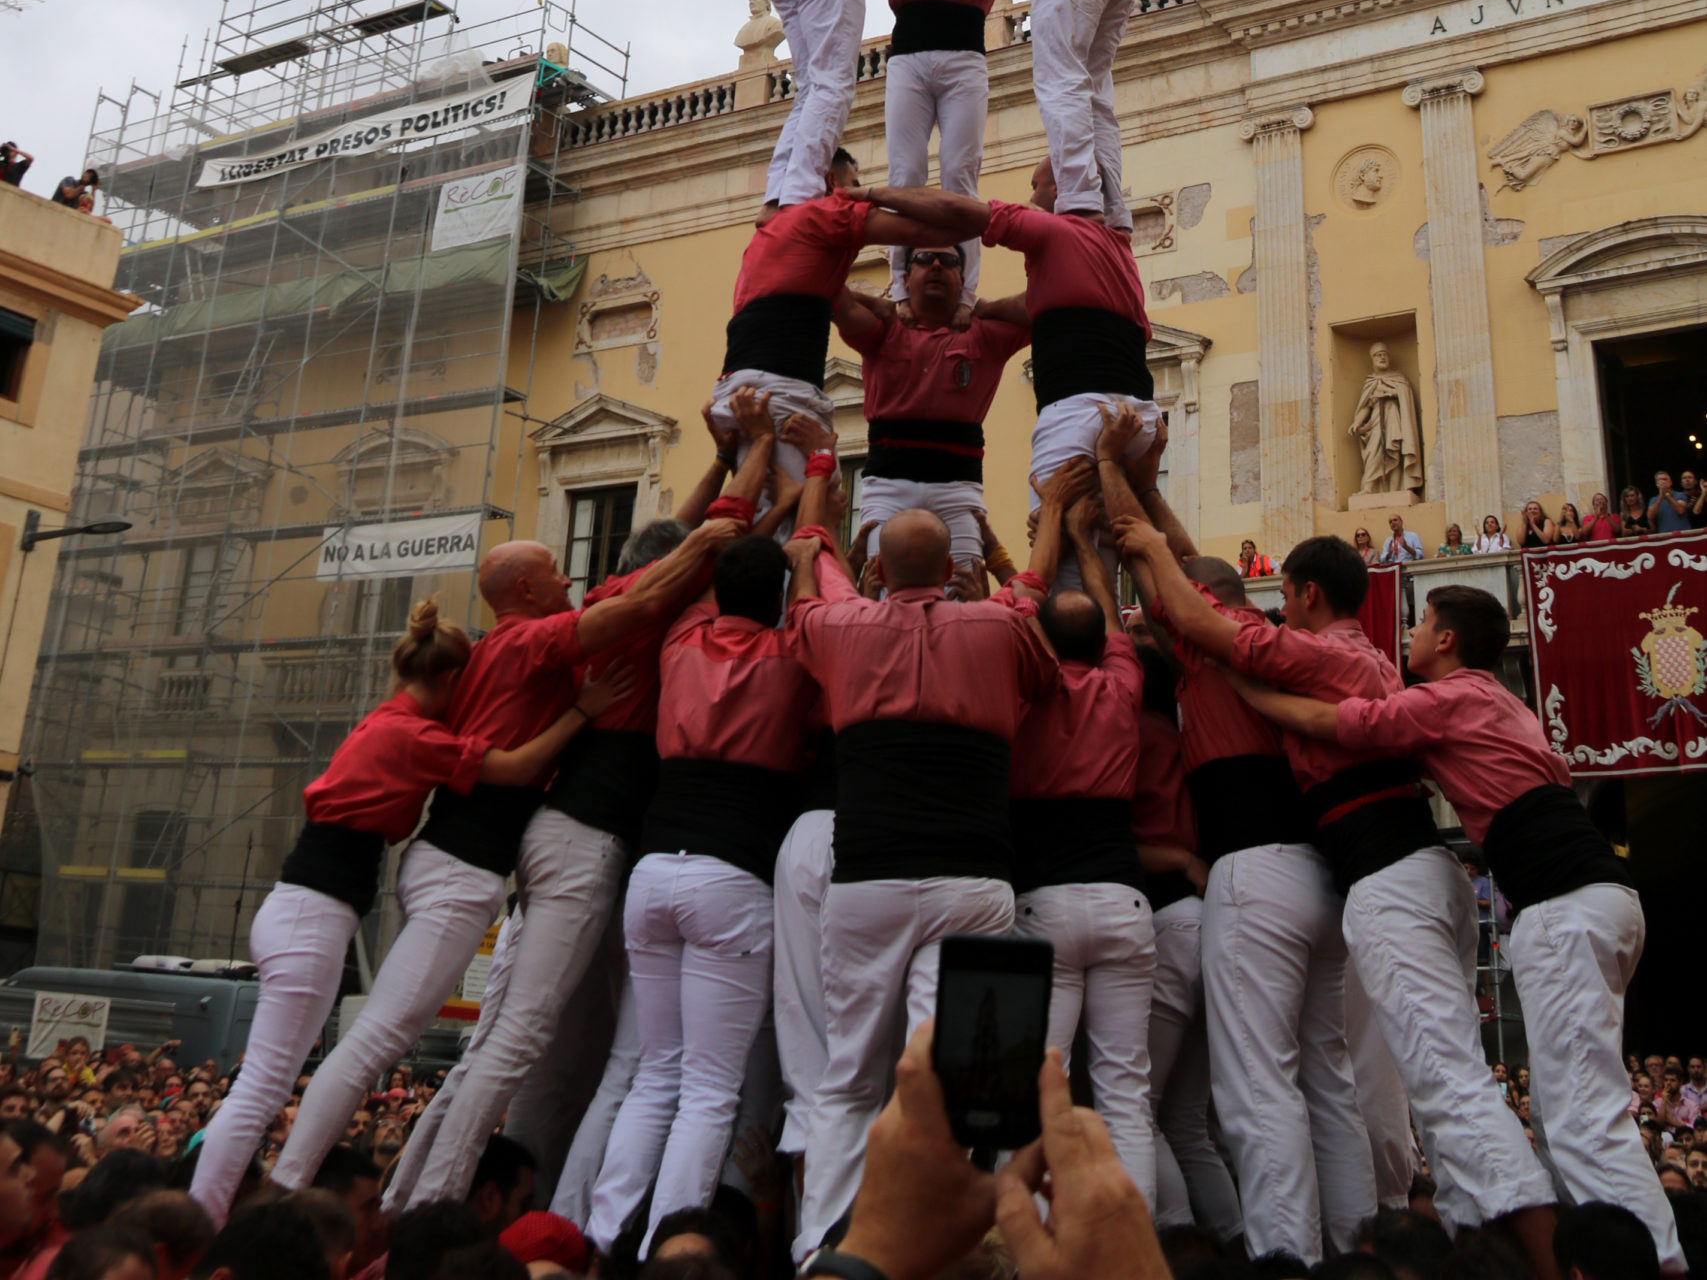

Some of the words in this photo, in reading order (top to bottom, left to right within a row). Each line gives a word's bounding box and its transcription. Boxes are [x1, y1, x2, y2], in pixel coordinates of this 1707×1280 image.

[315, 123, 393, 158] PRESOS
[400, 91, 507, 137] POLÍTICS!
[323, 545, 349, 563] NO
[352, 543, 365, 562] A
[369, 541, 392, 561] LA
[397, 533, 475, 558] GUERRA
